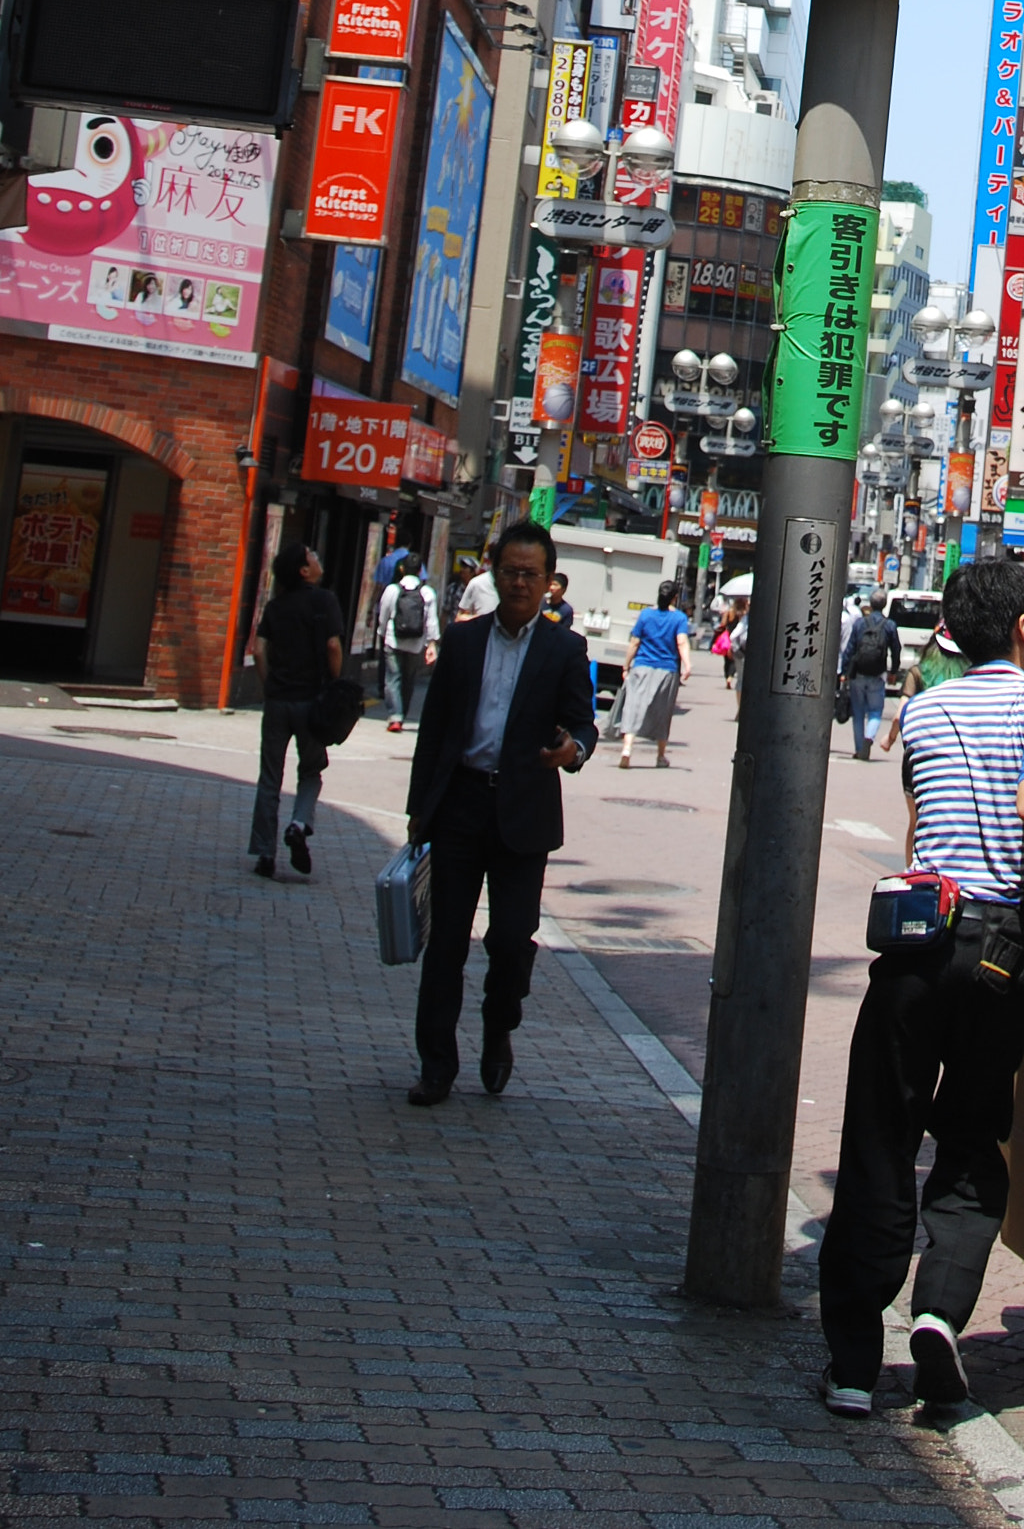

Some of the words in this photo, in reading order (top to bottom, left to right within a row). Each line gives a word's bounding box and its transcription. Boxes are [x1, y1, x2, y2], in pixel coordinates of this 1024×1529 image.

[337, 13, 401, 31] Kitchen
[351, 2, 389, 18] First
[331, 104, 387, 136] FK
[152, 165, 248, 228] 麻友
[315, 195, 379, 213] Kitchen
[329, 185, 367, 201] First
[542, 207, 666, 234] 渋谷センター街
[29, 260, 48, 271] Now
[49, 263, 63, 273] On
[813, 213, 868, 449] 客引きは犯罪です
[584, 360, 597, 373] 2F
[584, 316, 634, 424] 歌広場
[910, 362, 993, 382] 渋谷センター街
[311, 411, 408, 440] 1階・地下1階
[514, 434, 541, 447] B1F
[22, 513, 94, 543] ポテト
[801, 556, 826, 660] バスケットボール
[782, 621, 802, 686] ストリート
